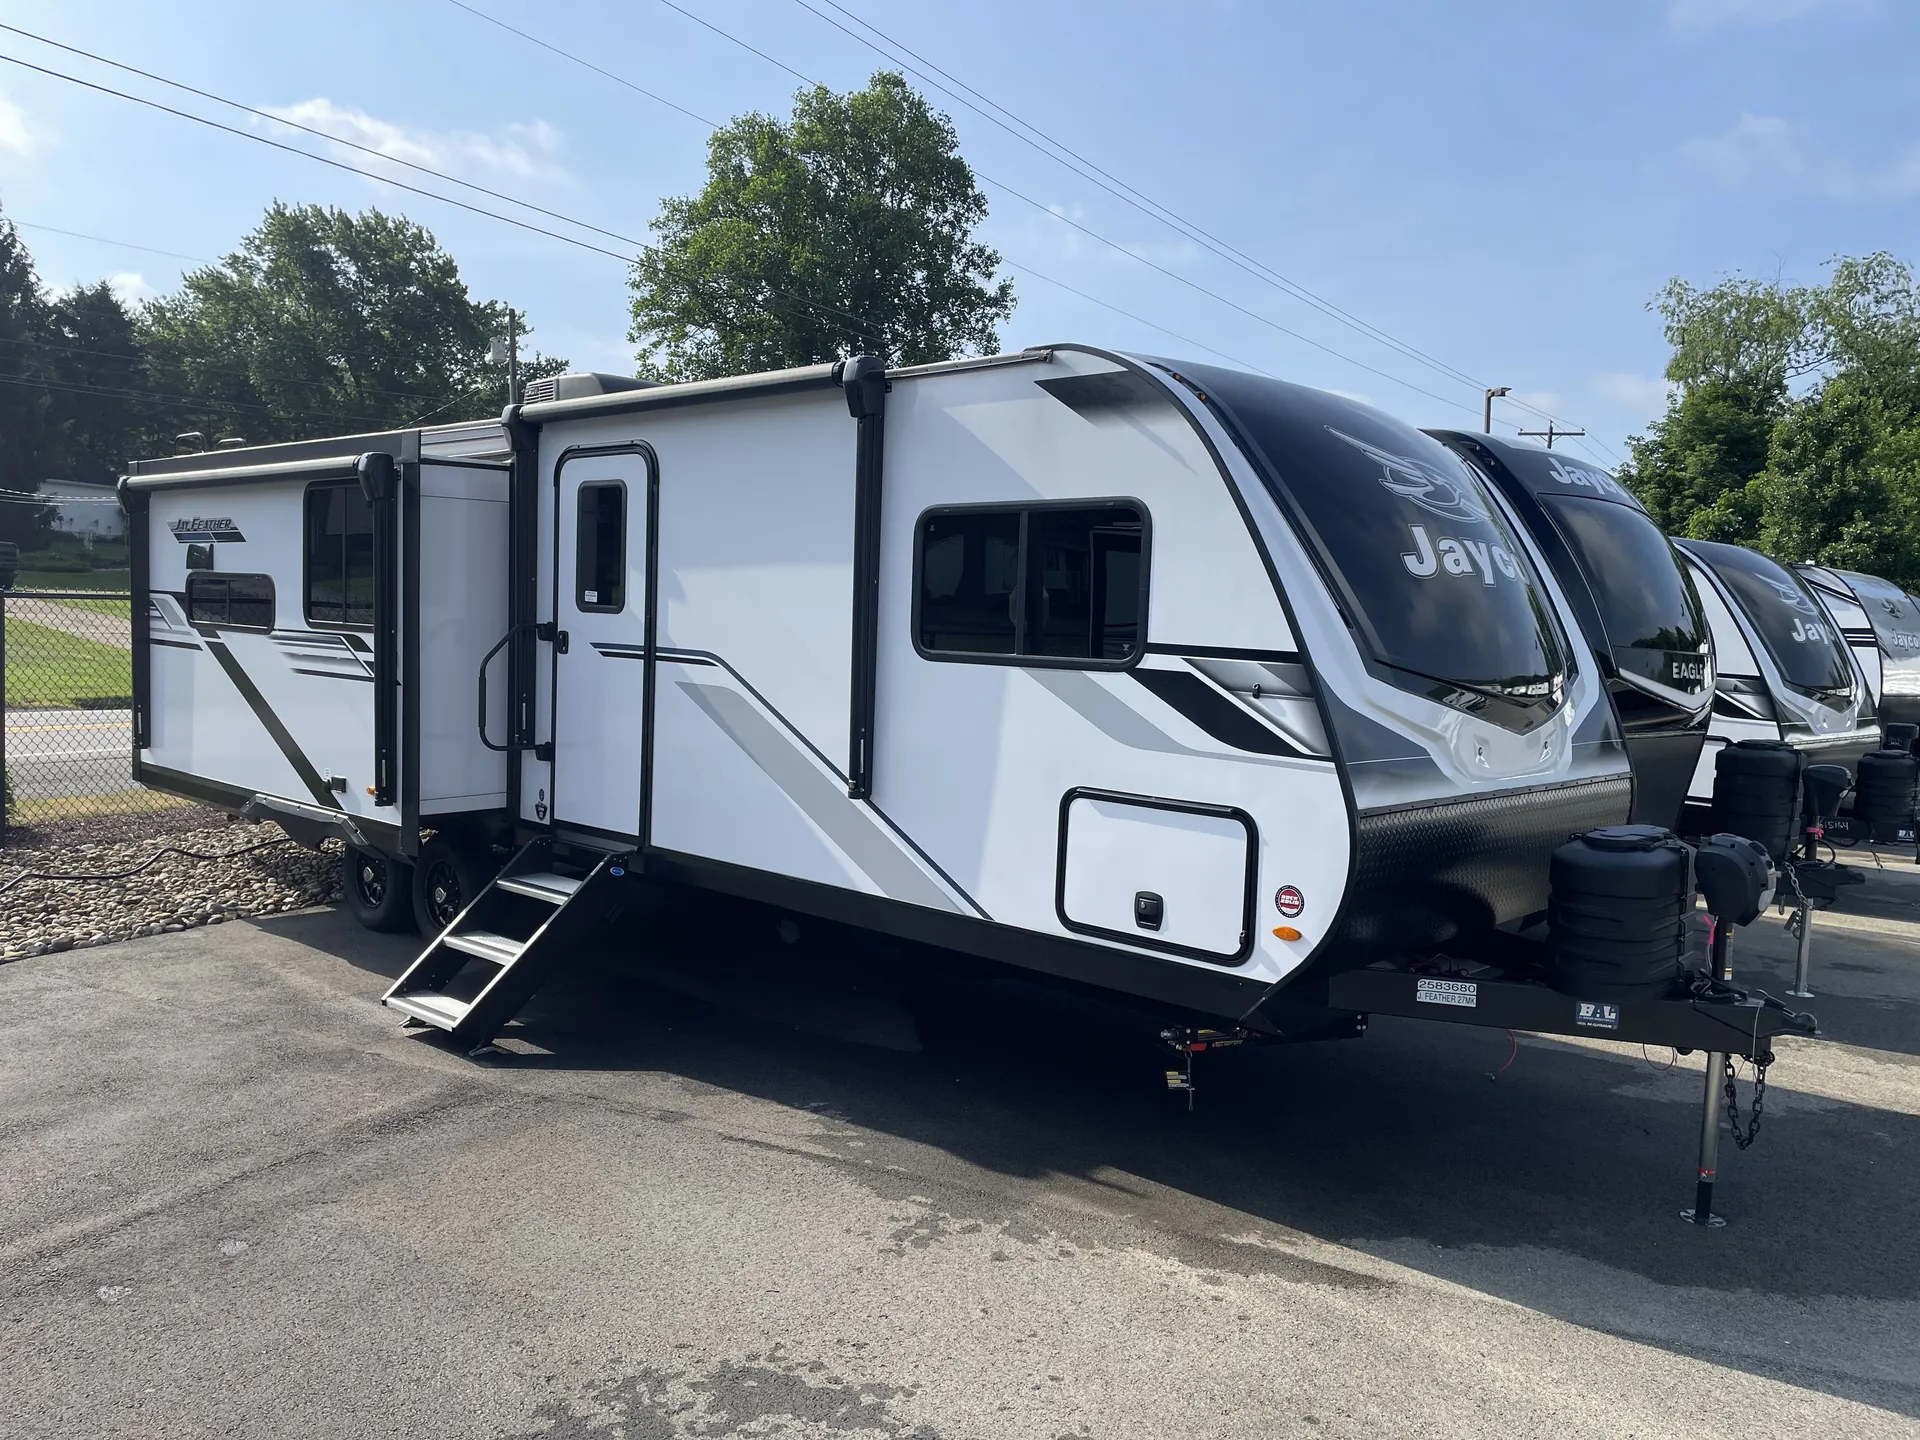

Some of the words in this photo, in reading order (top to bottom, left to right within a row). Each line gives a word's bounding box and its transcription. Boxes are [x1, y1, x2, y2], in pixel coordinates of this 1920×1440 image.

[175, 518, 190, 530] JAY
[191, 517, 232, 530] FEATHER
[1892, 628, 1919, 651] Jayco
[1672, 662, 1704, 680] EAGLE
[1418, 980, 1476, 993] 2583680
[1425, 993, 1456, 1003] FEATHER
[1457, 996, 1476, 1005] 27MK
